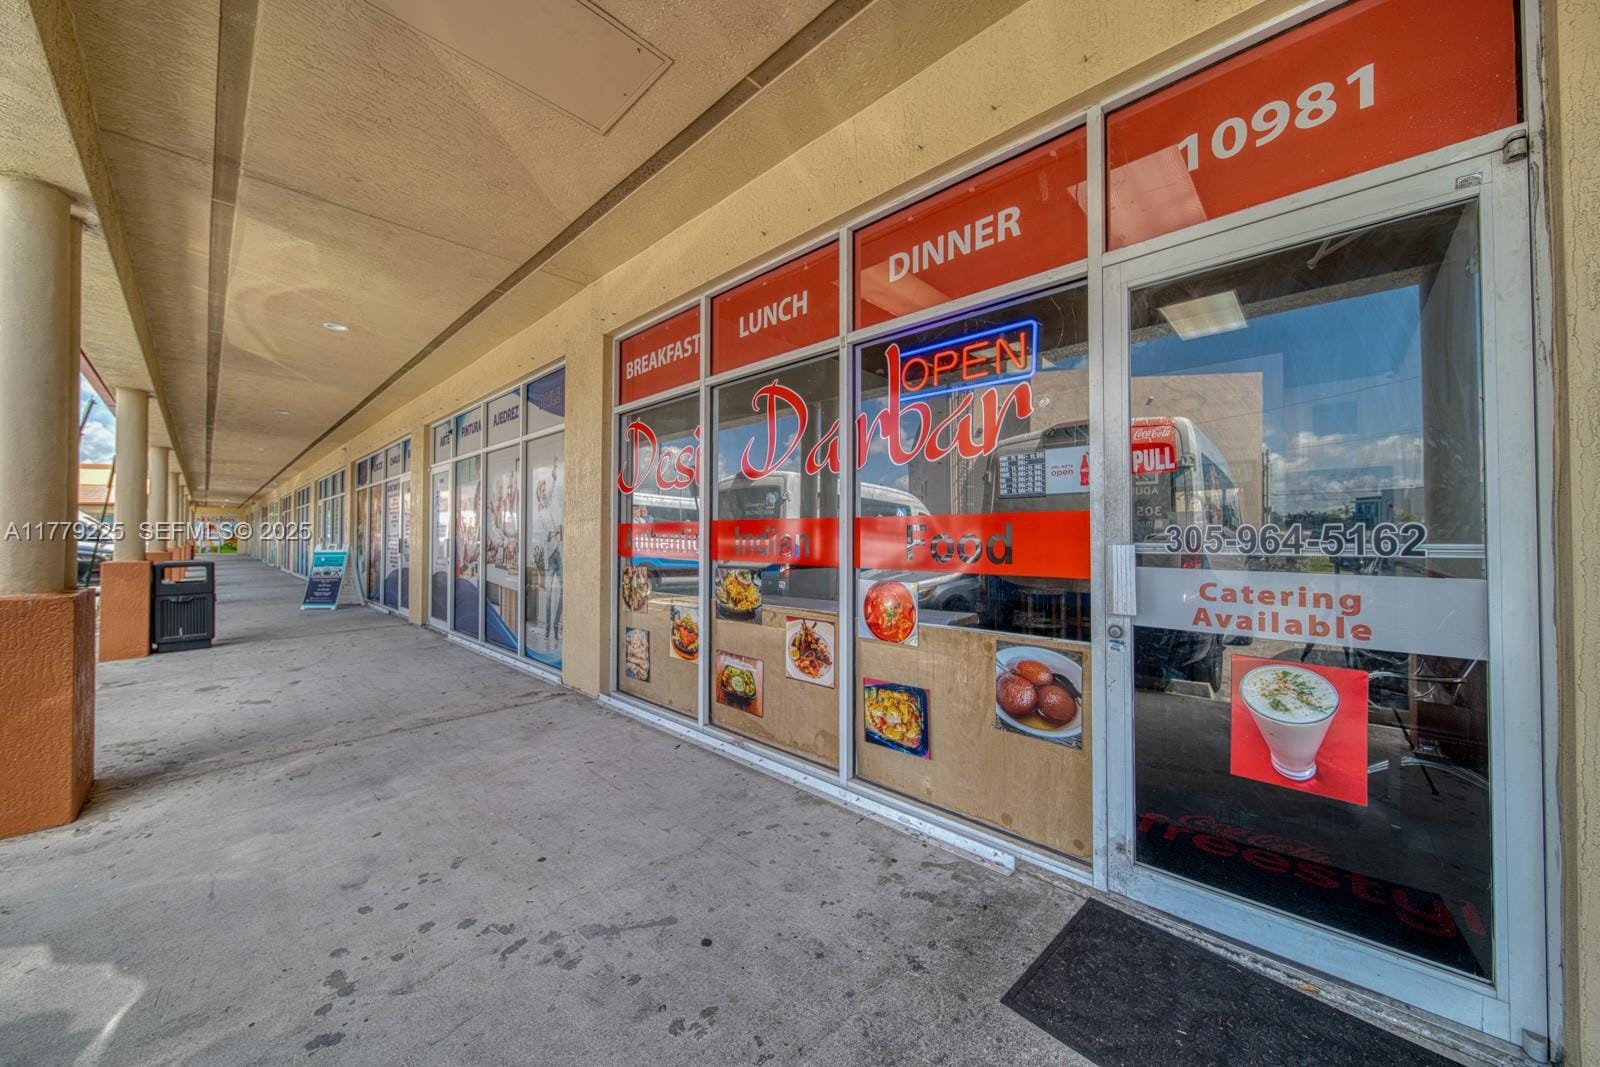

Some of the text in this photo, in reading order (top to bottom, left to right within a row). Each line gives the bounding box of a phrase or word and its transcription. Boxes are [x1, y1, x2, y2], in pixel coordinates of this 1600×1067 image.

[1177, 62, 1376, 172] 10981
[887, 205, 1022, 284] DINNER
[738, 289, 809, 339] LUNCH
[625, 332, 701, 380] BREAKFAST
[901, 331, 1028, 392] OPEN
[493, 404, 520, 428] AJEDREZ
[740, 342, 1035, 481] Darbar
[1050, 468, 1074, 478] open
[1132, 447, 1176, 473] PULL
[734, 525, 810, 559] Indian
[905, 521, 1013, 566] Food
[1164, 521, 1428, 559] 305-964-5162
[1198, 581, 1362, 617] Catering
[1191, 607, 1373, 642] Available
